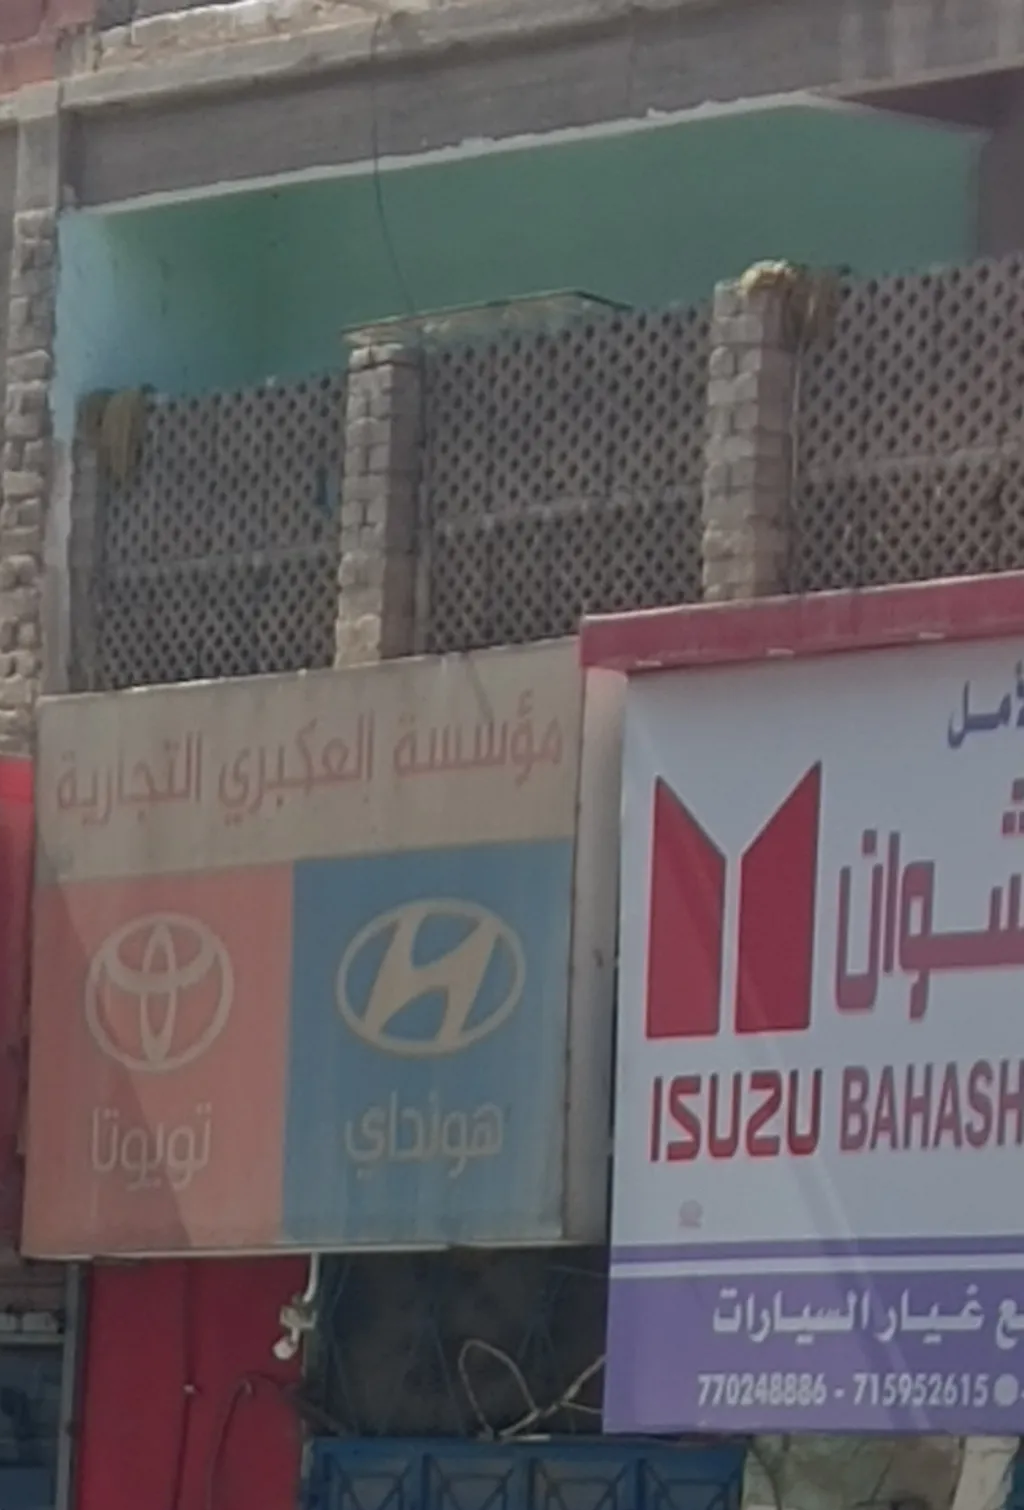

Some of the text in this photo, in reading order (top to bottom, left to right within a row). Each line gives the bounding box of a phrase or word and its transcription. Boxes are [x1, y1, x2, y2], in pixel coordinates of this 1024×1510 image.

[56, 732, 204, 826] التجارية
[393, 691, 565, 785] مؤسسة
[91, 1102, 213, 1191] تويوتا
[344, 1090, 504, 1176] هونداي
[649, 1058, 1024, 1164] ISUZU BAHASH
[712, 1287, 870, 1345] السيارات
[875, 1284, 984, 1343] غيار
[853, 1373, 990, 1407] 715952615
